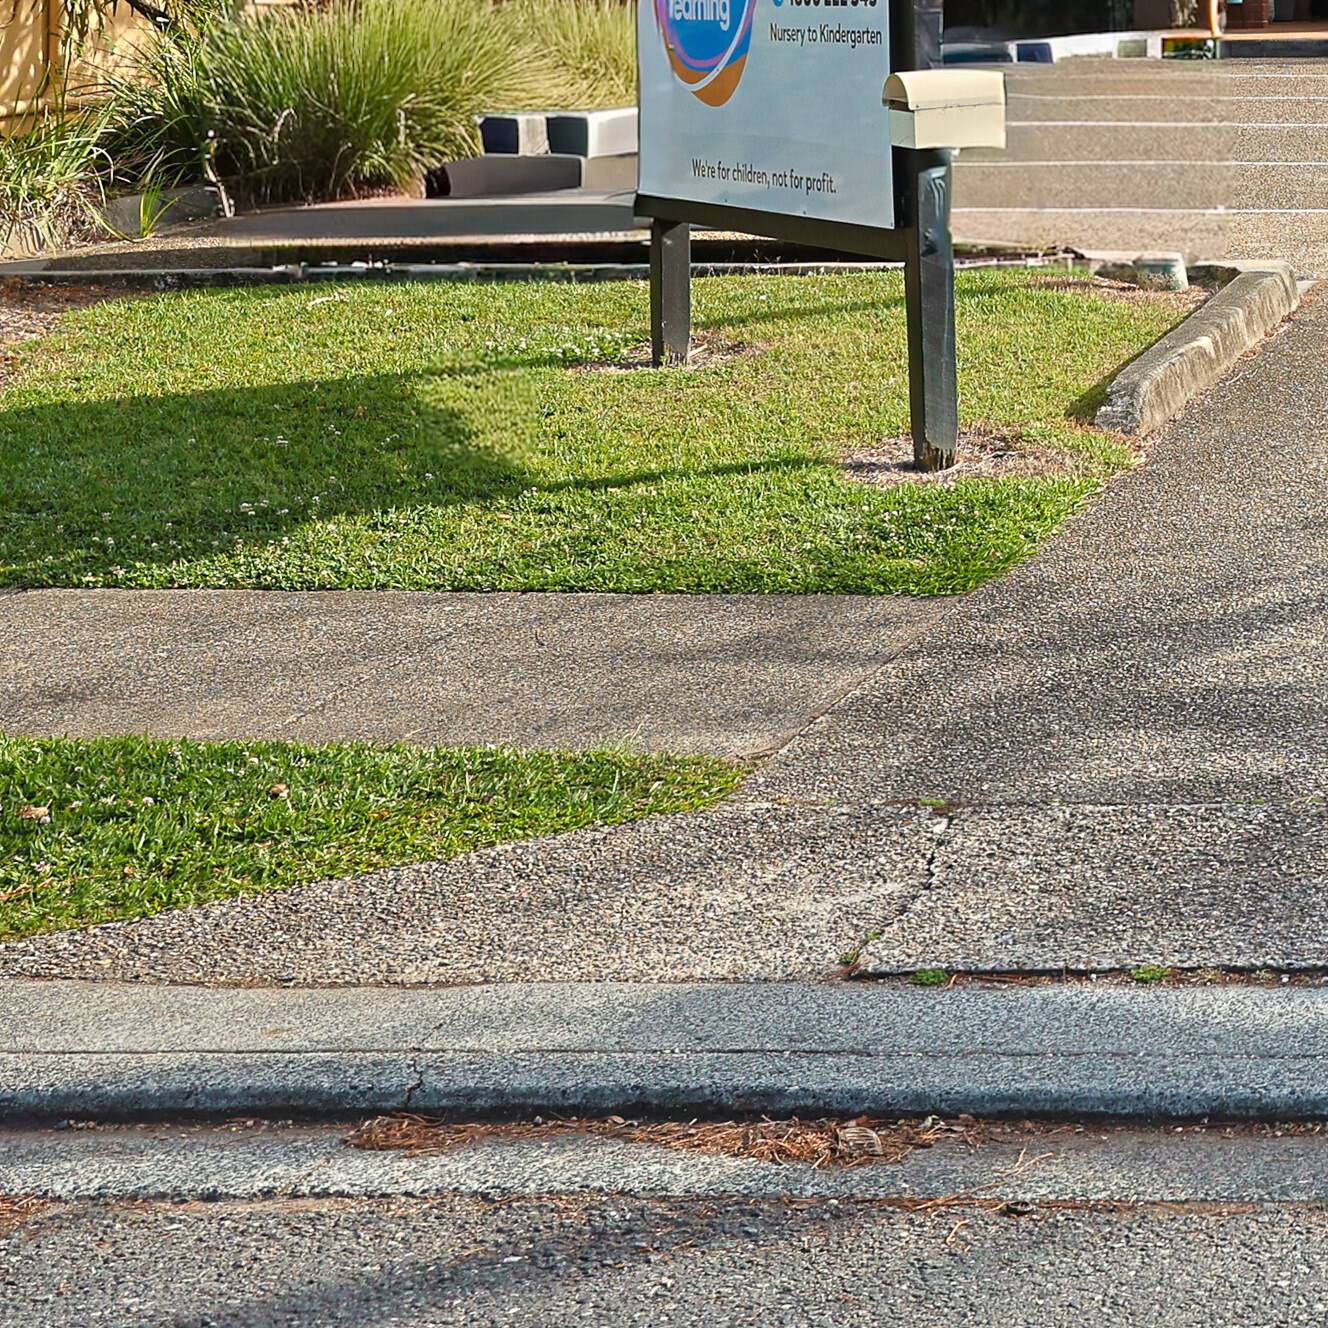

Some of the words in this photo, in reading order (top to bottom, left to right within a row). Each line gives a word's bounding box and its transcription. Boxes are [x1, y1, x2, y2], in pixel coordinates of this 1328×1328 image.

[770, 23, 805, 46] Nursery
[807, 26, 818, 42] to
[820, 23, 882, 48] Kindergarten
[692, 158, 716, 178] We're
[717, 161, 730, 180] for
[732, 163, 770, 189] children,
[772, 170, 788, 187] not
[790, 169, 804, 189] for
[805, 172, 836, 195] profit.
